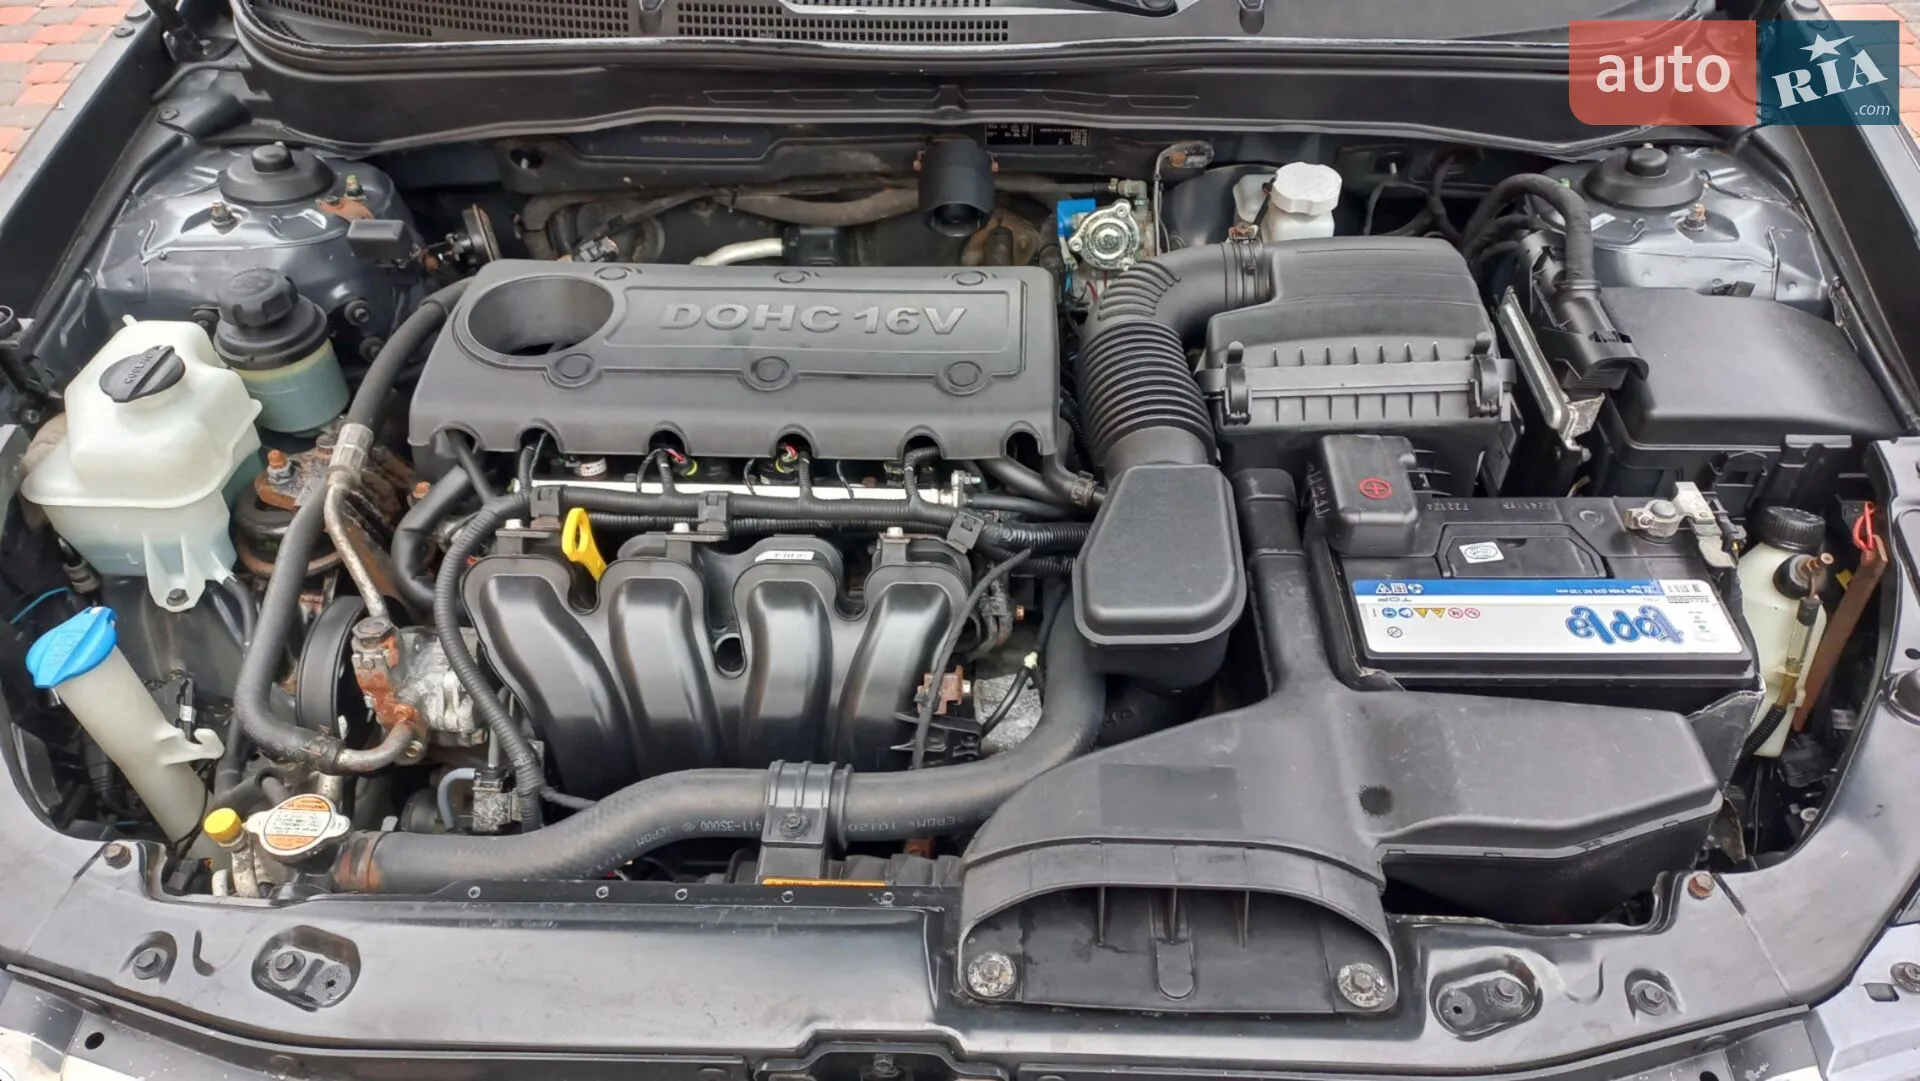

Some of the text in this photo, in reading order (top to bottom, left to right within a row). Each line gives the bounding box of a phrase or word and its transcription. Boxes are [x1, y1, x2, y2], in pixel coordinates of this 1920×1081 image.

[659, 302, 967, 335] DOHC 16V
[1565, 605, 1685, 645] topla
